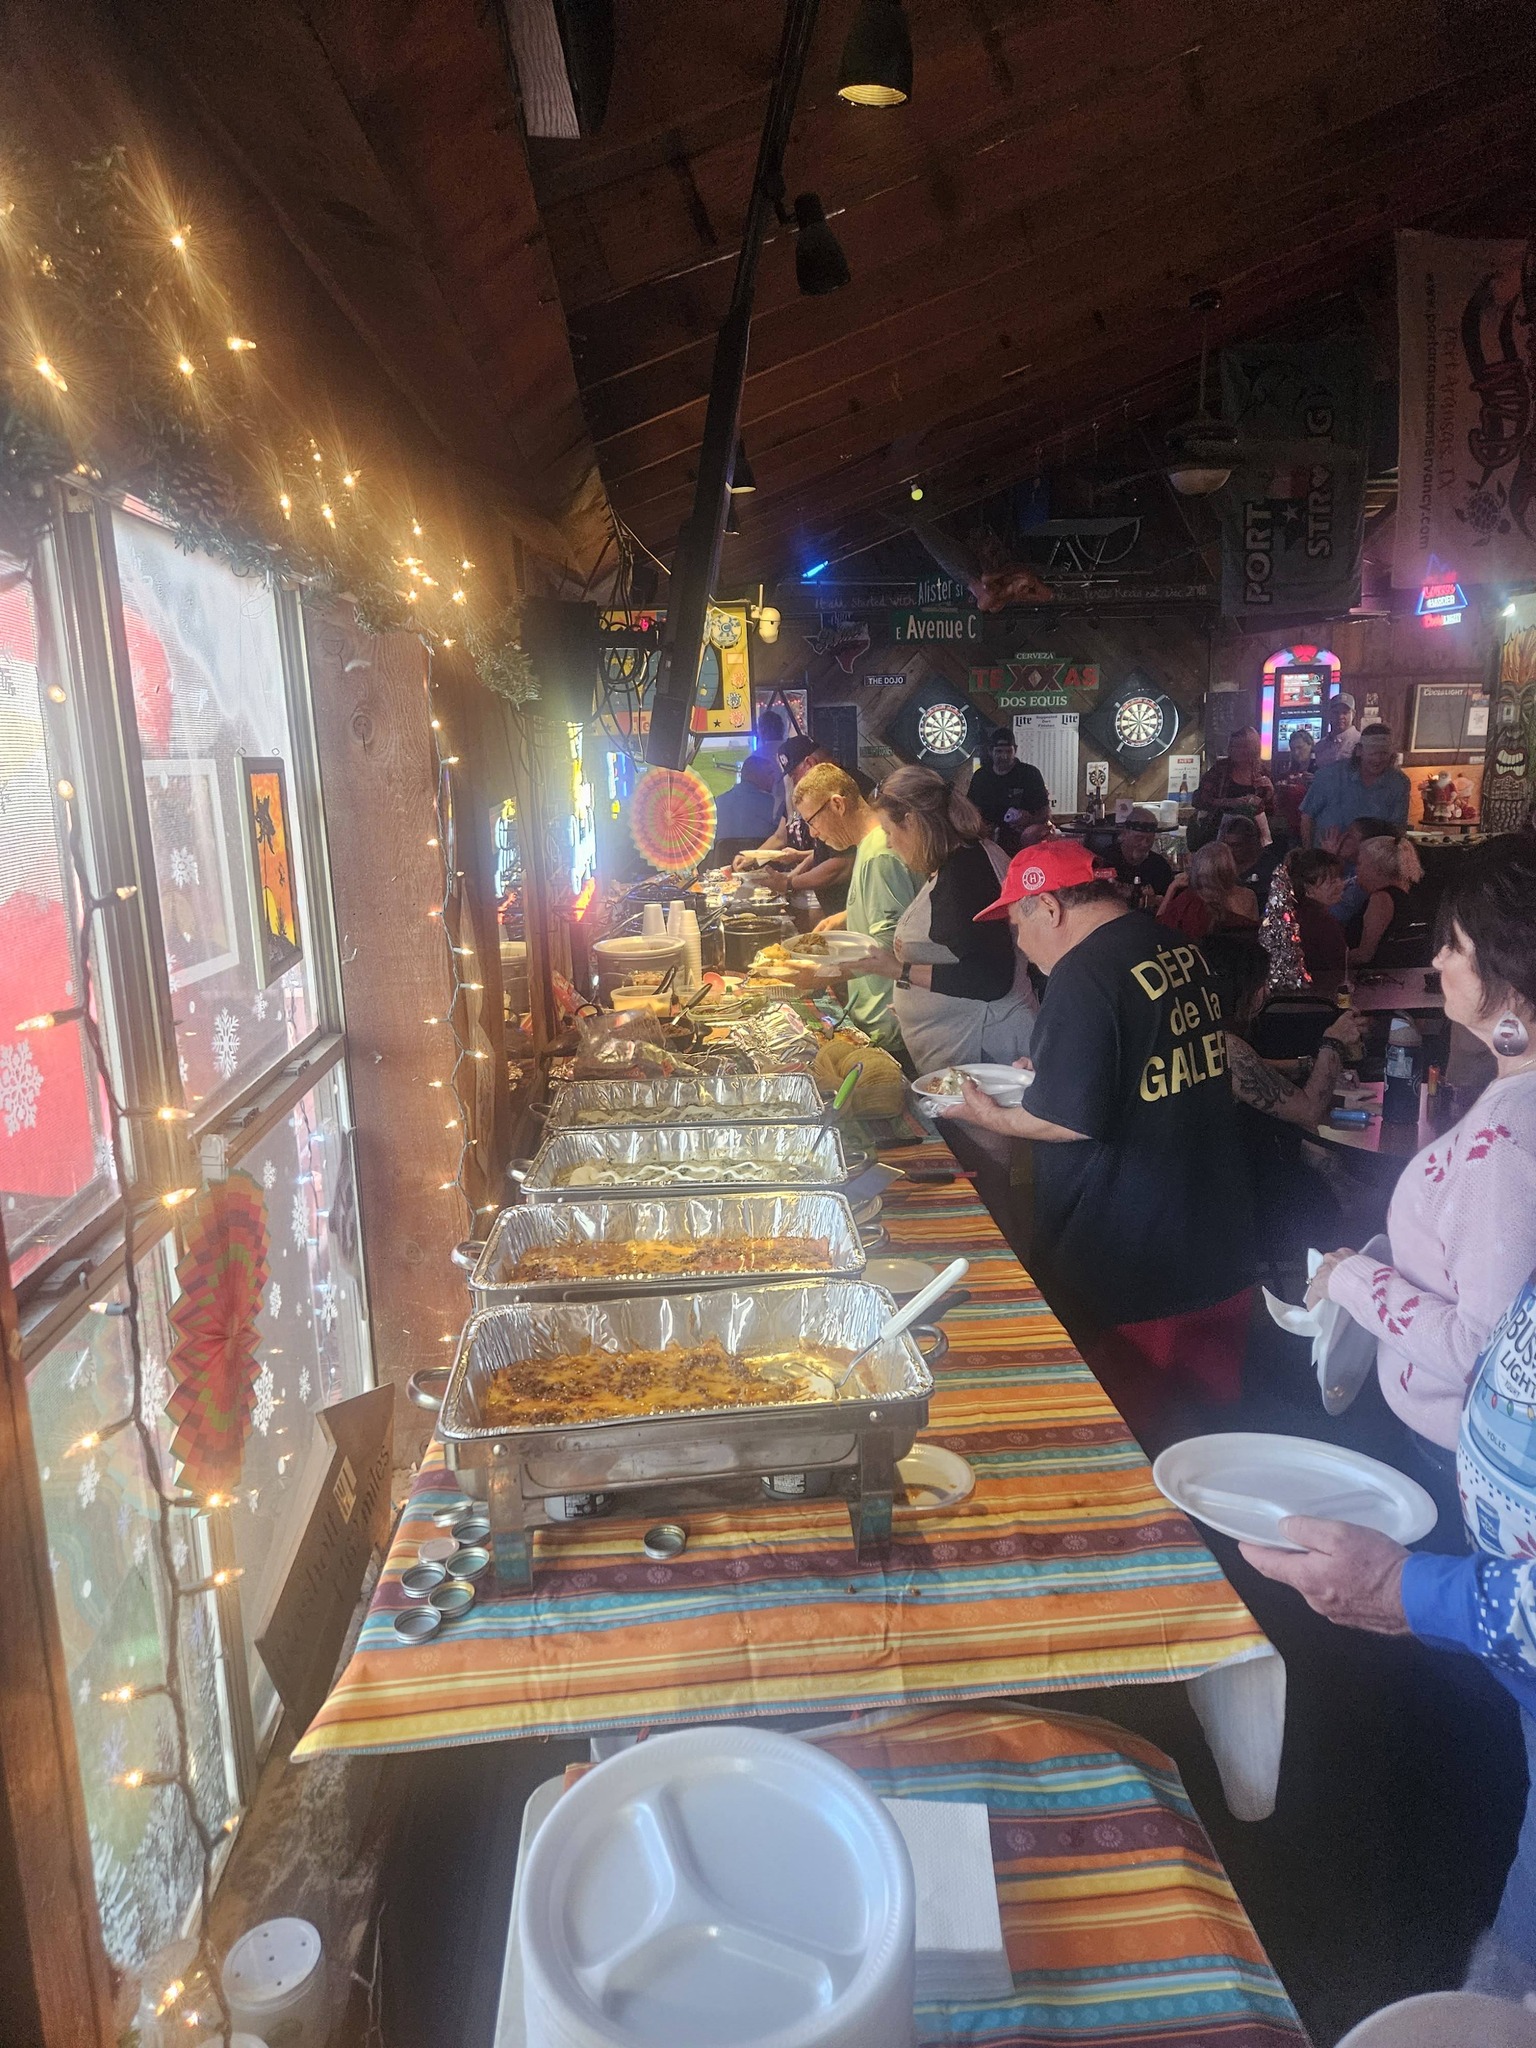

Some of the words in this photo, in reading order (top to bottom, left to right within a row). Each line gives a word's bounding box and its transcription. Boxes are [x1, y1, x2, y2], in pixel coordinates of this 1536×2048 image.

[1243, 502, 1273, 604] PORT
[918, 577, 953, 605] Alister
[895, 626, 902, 640] E
[906, 614, 963, 640] Avenue
[967, 614, 977, 639] C
[1015, 652, 1055, 660] CERVEZA
[869, 677, 883, 685] THE
[884, 676, 904, 685] DOJO
[1445, 688, 1464, 696] LIGHT
[1000, 697, 1027, 708] DOS
[1029, 696, 1068, 708] EQUIS
[1015, 716, 1032, 728] Lite
[1061, 714, 1078, 726] Lite
[1029, 873, 1037, 884] H
[1169, 996, 1200, 1036] de
[1201, 986, 1223, 1022] la
[1500, 1350, 1536, 1399] LIGHT
